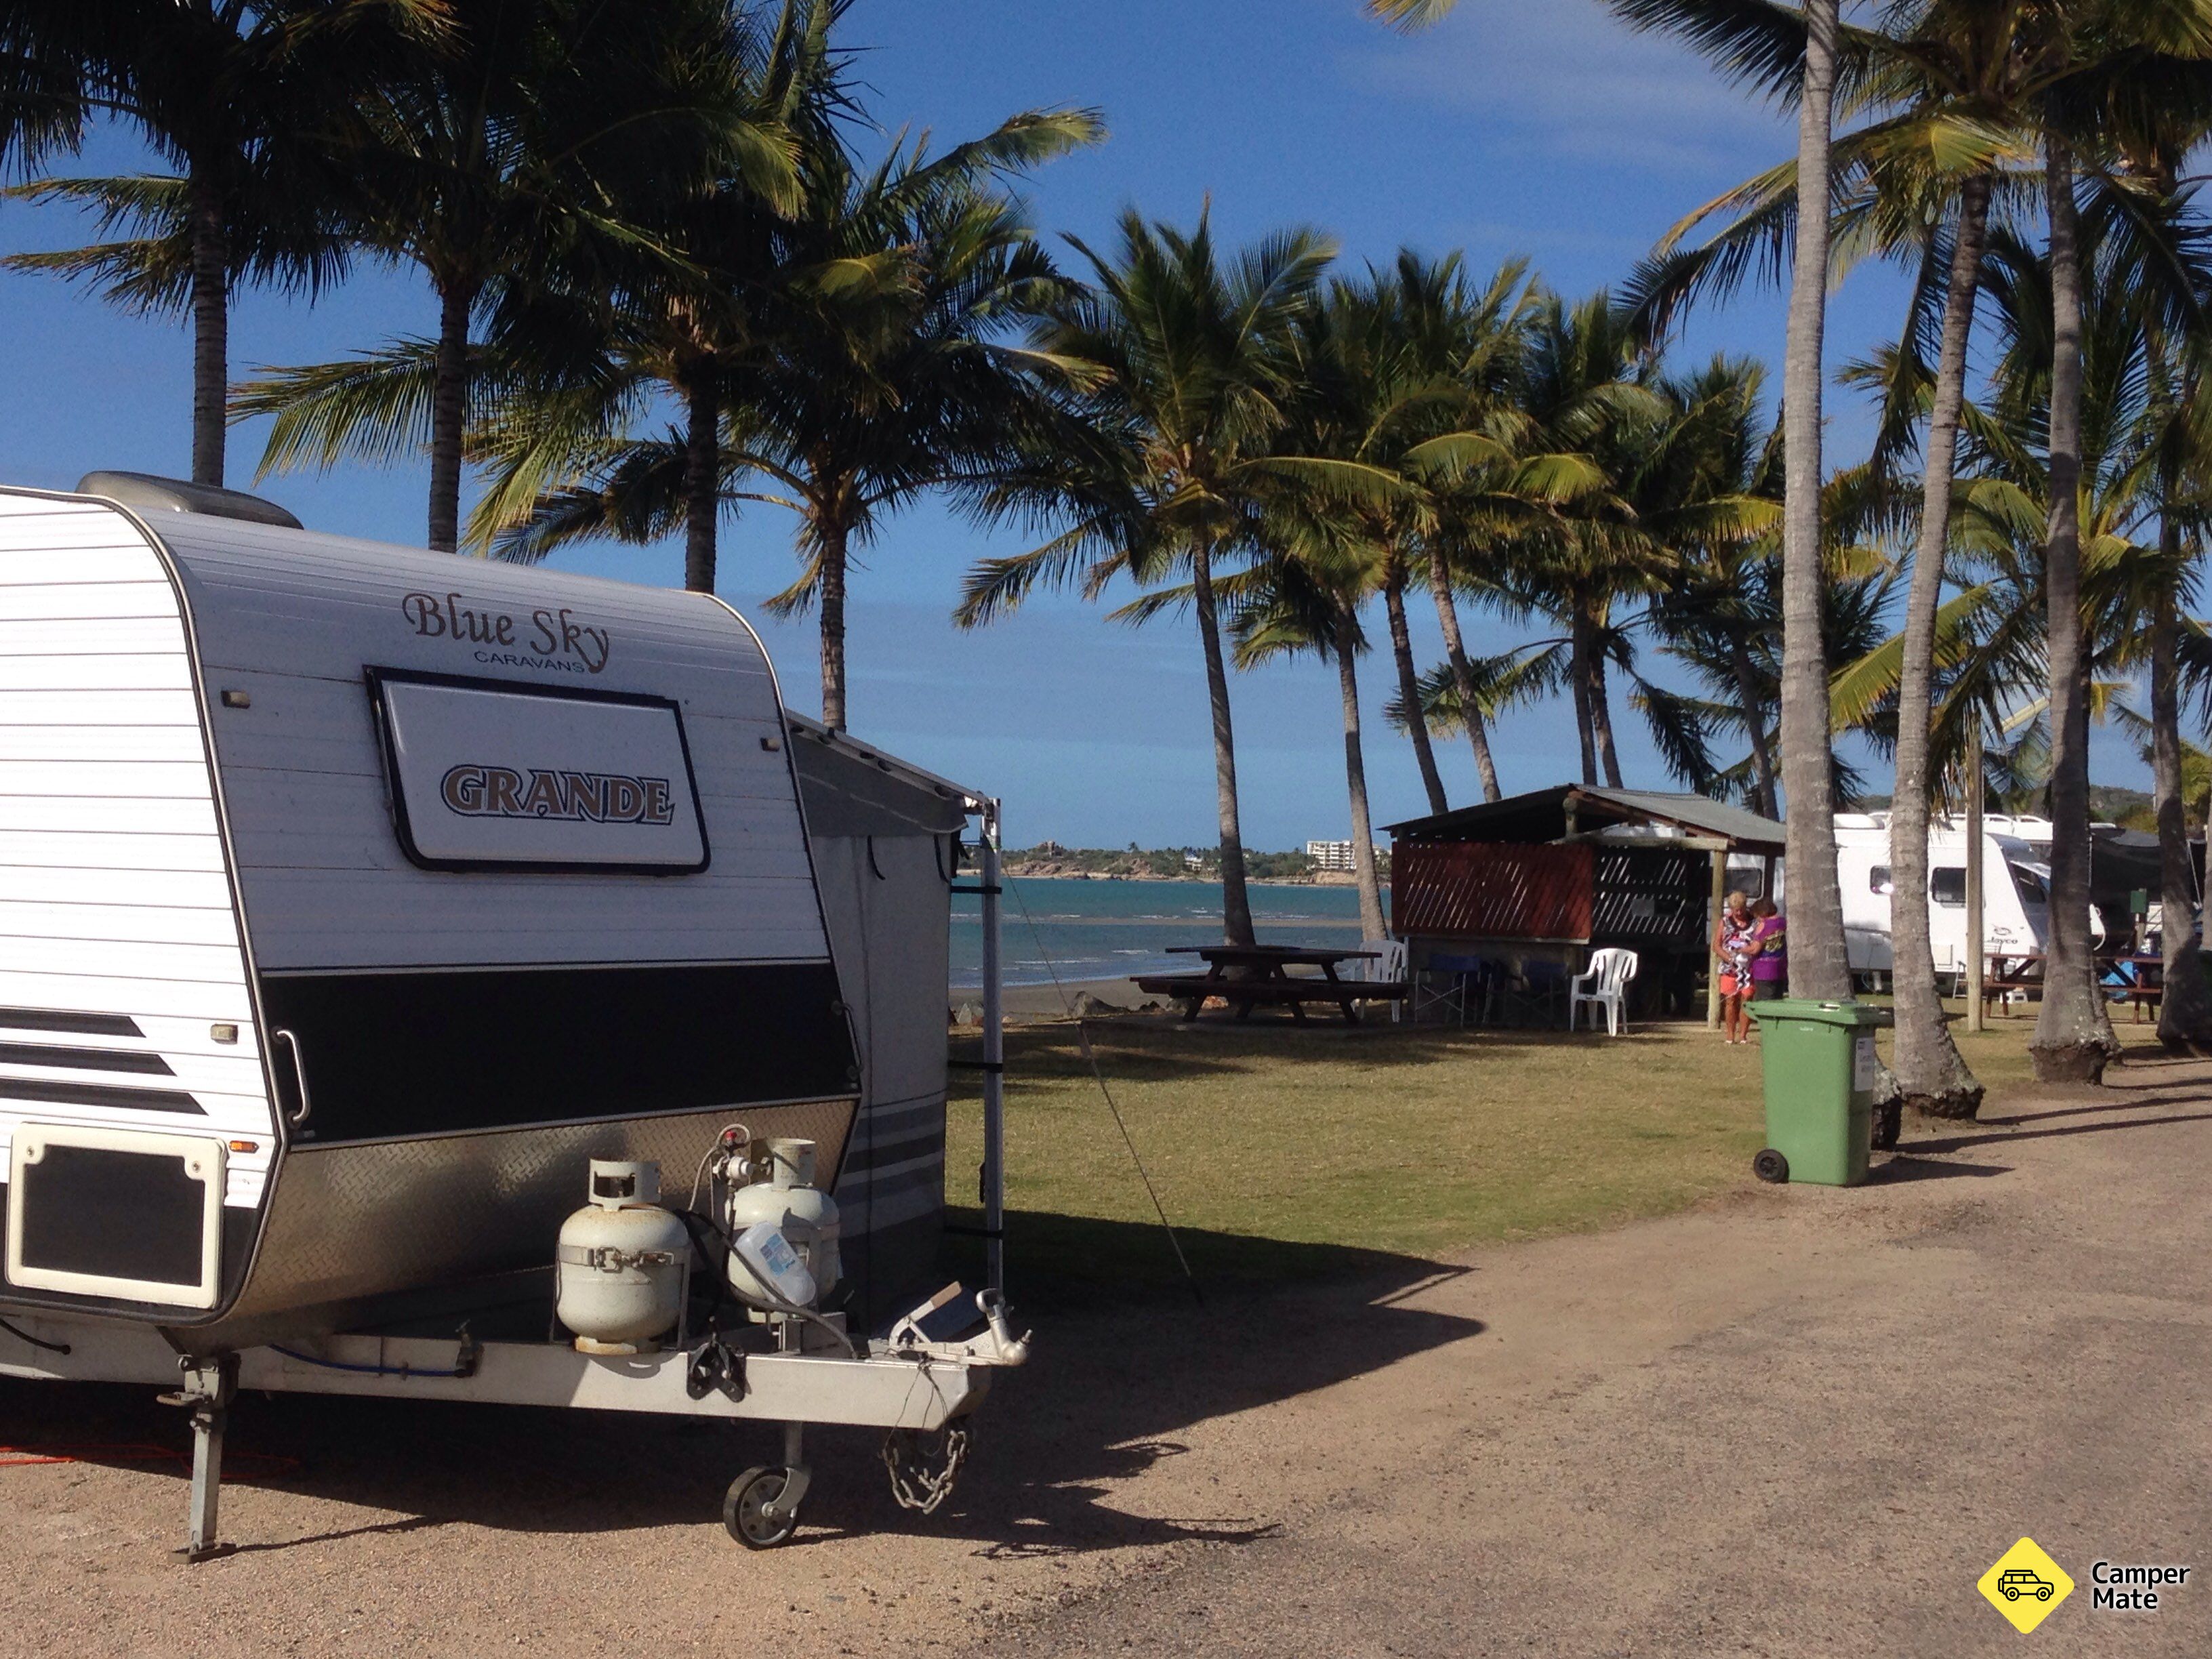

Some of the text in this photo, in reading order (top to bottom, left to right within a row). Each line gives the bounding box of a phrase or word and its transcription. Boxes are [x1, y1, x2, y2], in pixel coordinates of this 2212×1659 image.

[402, 592, 609, 674] Blue Sky
[474, 650, 585, 674] CARAVANS
[441, 764, 675, 825] GRANDE
